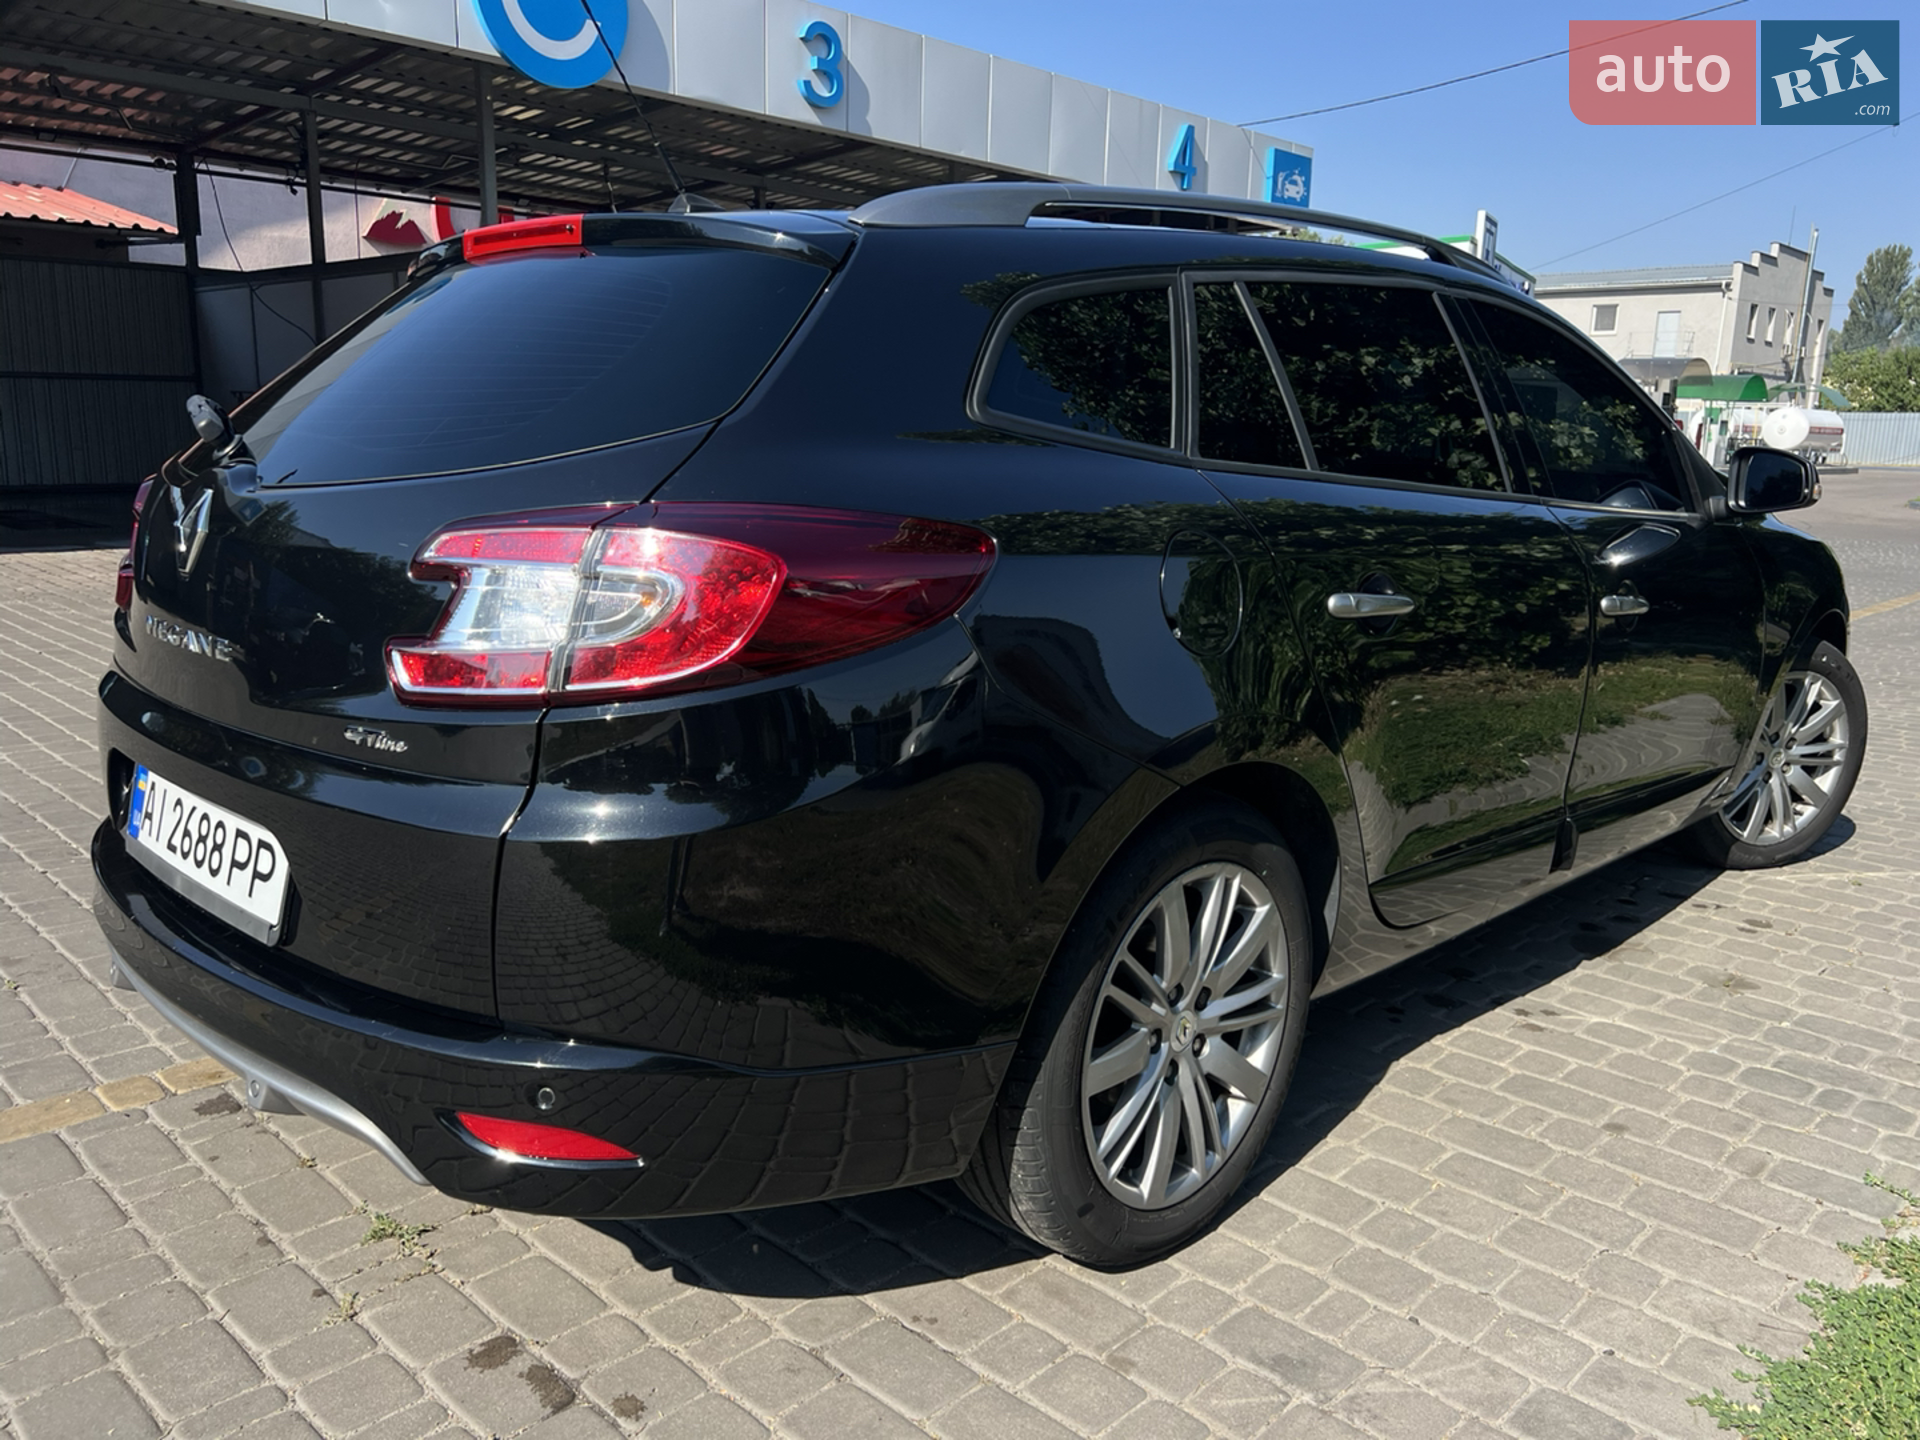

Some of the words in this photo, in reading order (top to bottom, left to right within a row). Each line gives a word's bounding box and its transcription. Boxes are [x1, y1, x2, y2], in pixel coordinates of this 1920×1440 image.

[797, 20, 843, 108] 3
[1167, 123, 1197, 191] 4
[141, 781, 167, 842] AI
[166, 797, 227, 878] 2688
[226, 827, 276, 898] PP
